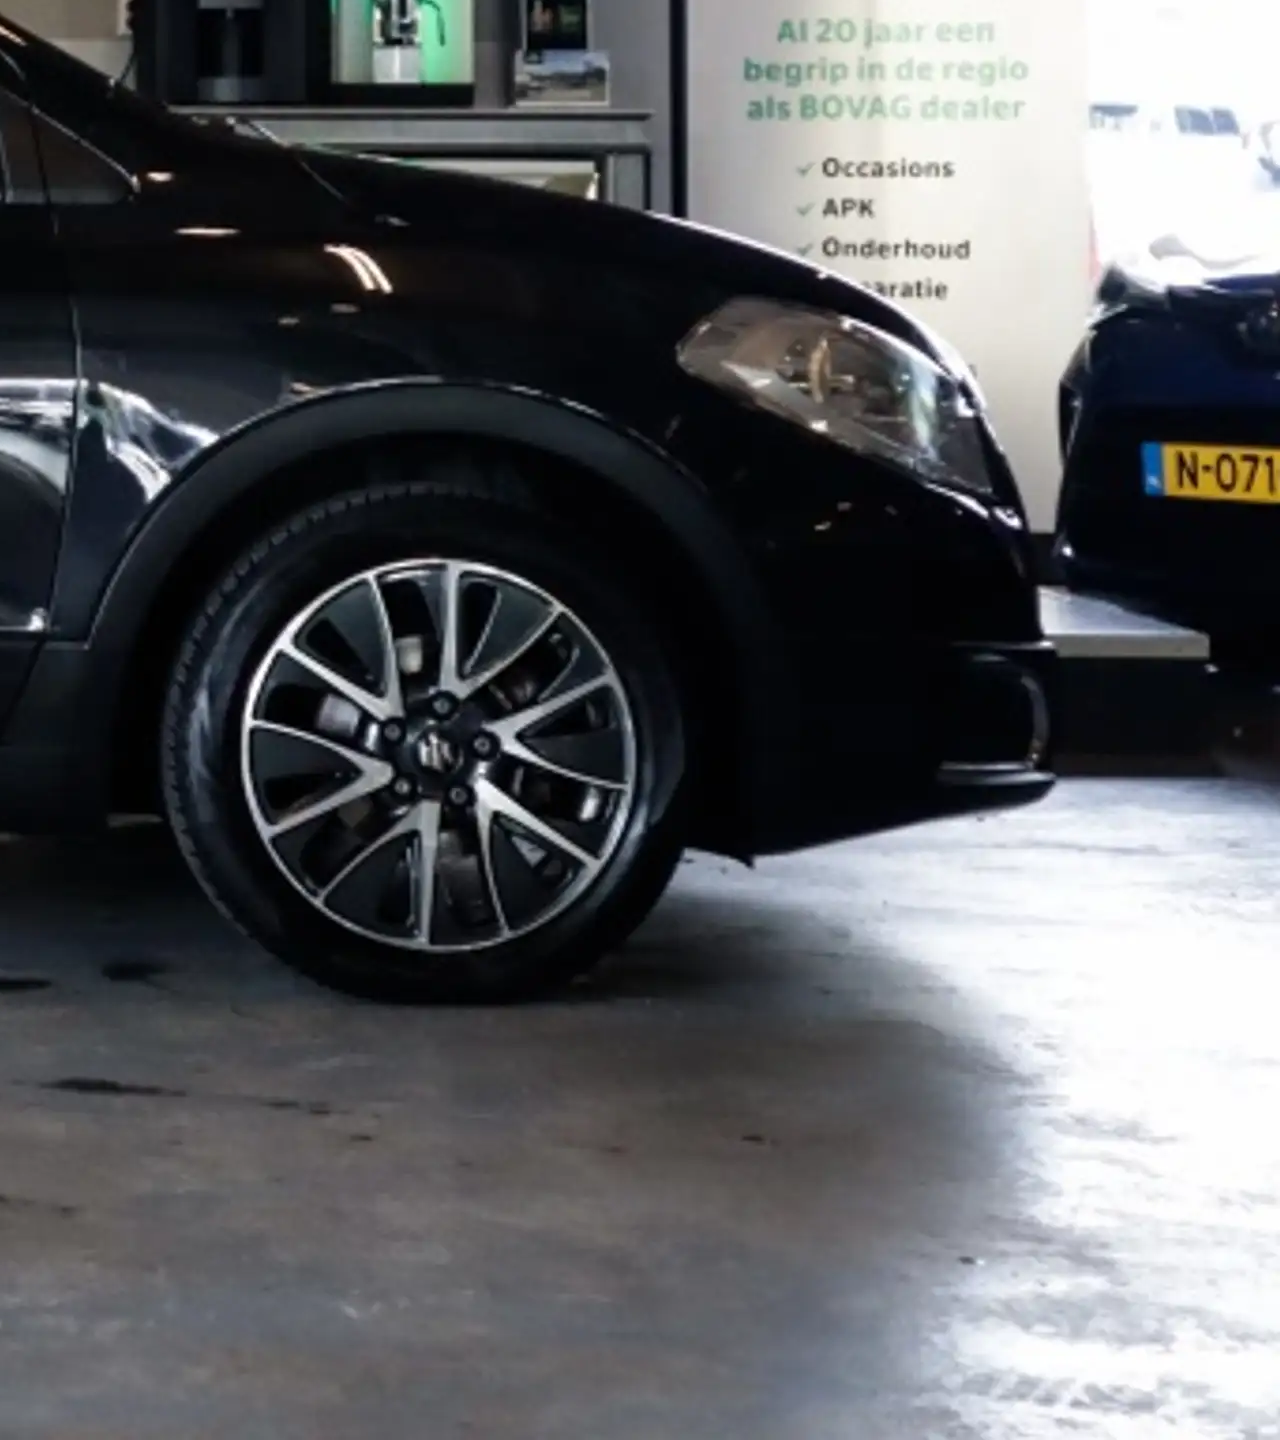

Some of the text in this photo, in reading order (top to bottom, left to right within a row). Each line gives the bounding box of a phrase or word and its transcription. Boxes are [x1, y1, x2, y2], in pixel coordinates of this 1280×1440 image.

[776, 18, 996, 50] Al 20 jaar een
[743, 54, 1030, 88] begrip in de regio
[746, 93, 1028, 120] als BOVAG dealer
[821, 156, 957, 179] Occasions
[821, 197, 875, 219] APK
[821, 234, 973, 260] Onderhoud
[861, 276, 949, 301] aratie
